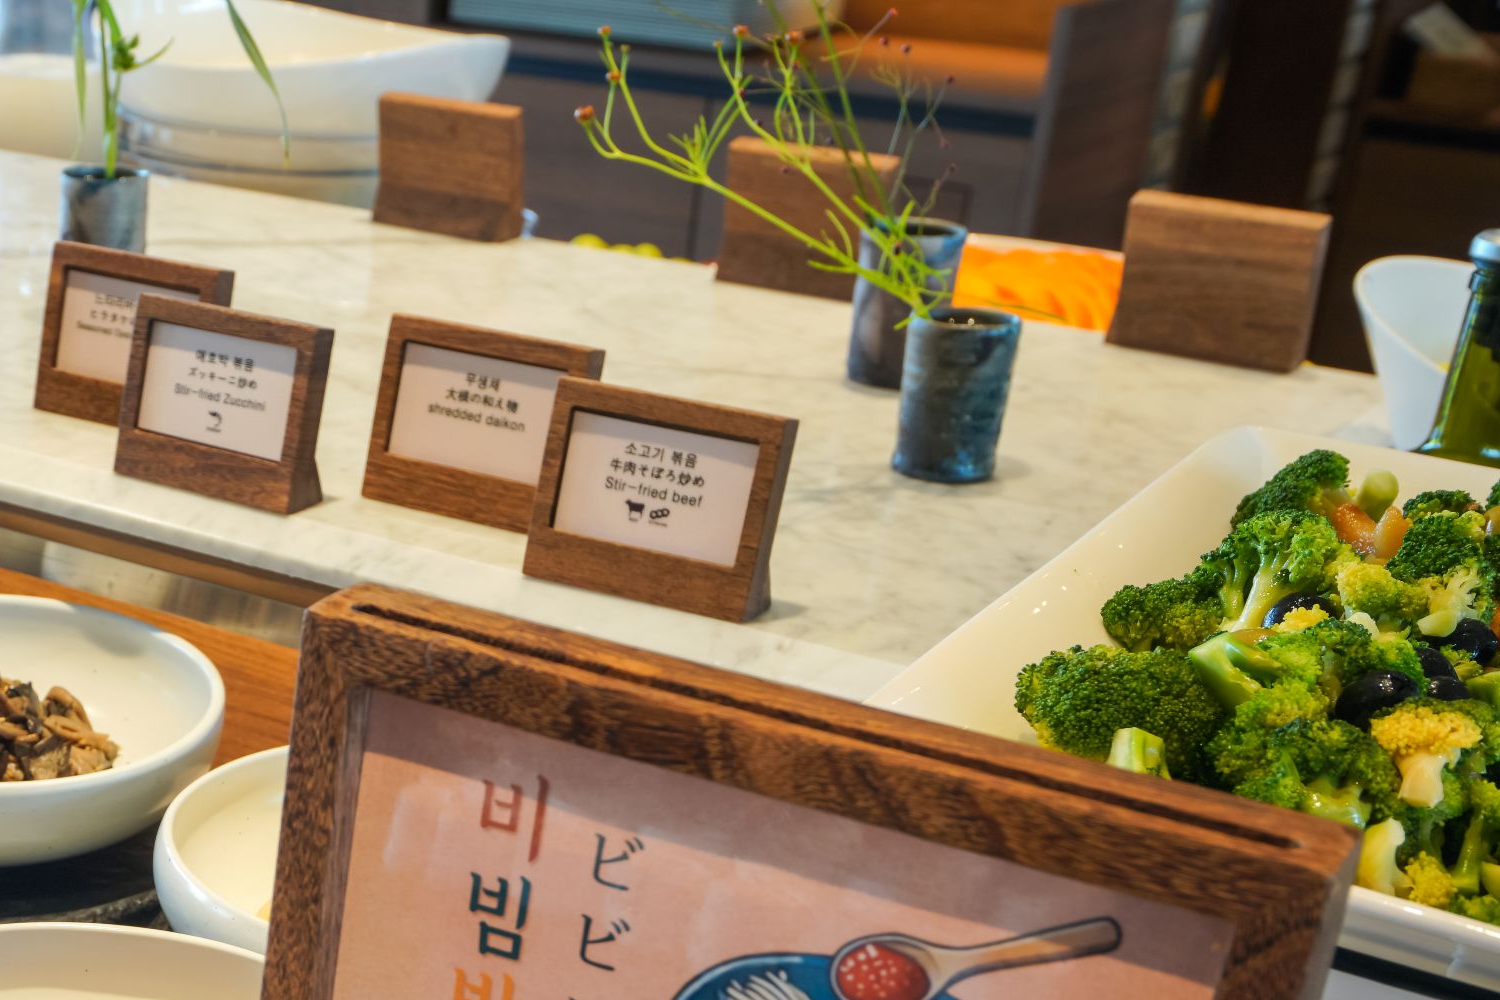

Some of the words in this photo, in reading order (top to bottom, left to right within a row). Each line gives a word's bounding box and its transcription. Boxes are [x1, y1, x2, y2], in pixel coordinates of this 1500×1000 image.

[222, 392, 266, 412] Zucchini
[427, 403, 482, 424] shredded
[485, 415, 526, 433] daikon
[624, 442, 665, 463] 소고기
[671, 450, 698, 469] 볶음
[609, 458, 705, 488] 牛肉そぼろ炒め
[604, 475, 668, 501] Stir-fried
[671, 489, 703, 508] beef
